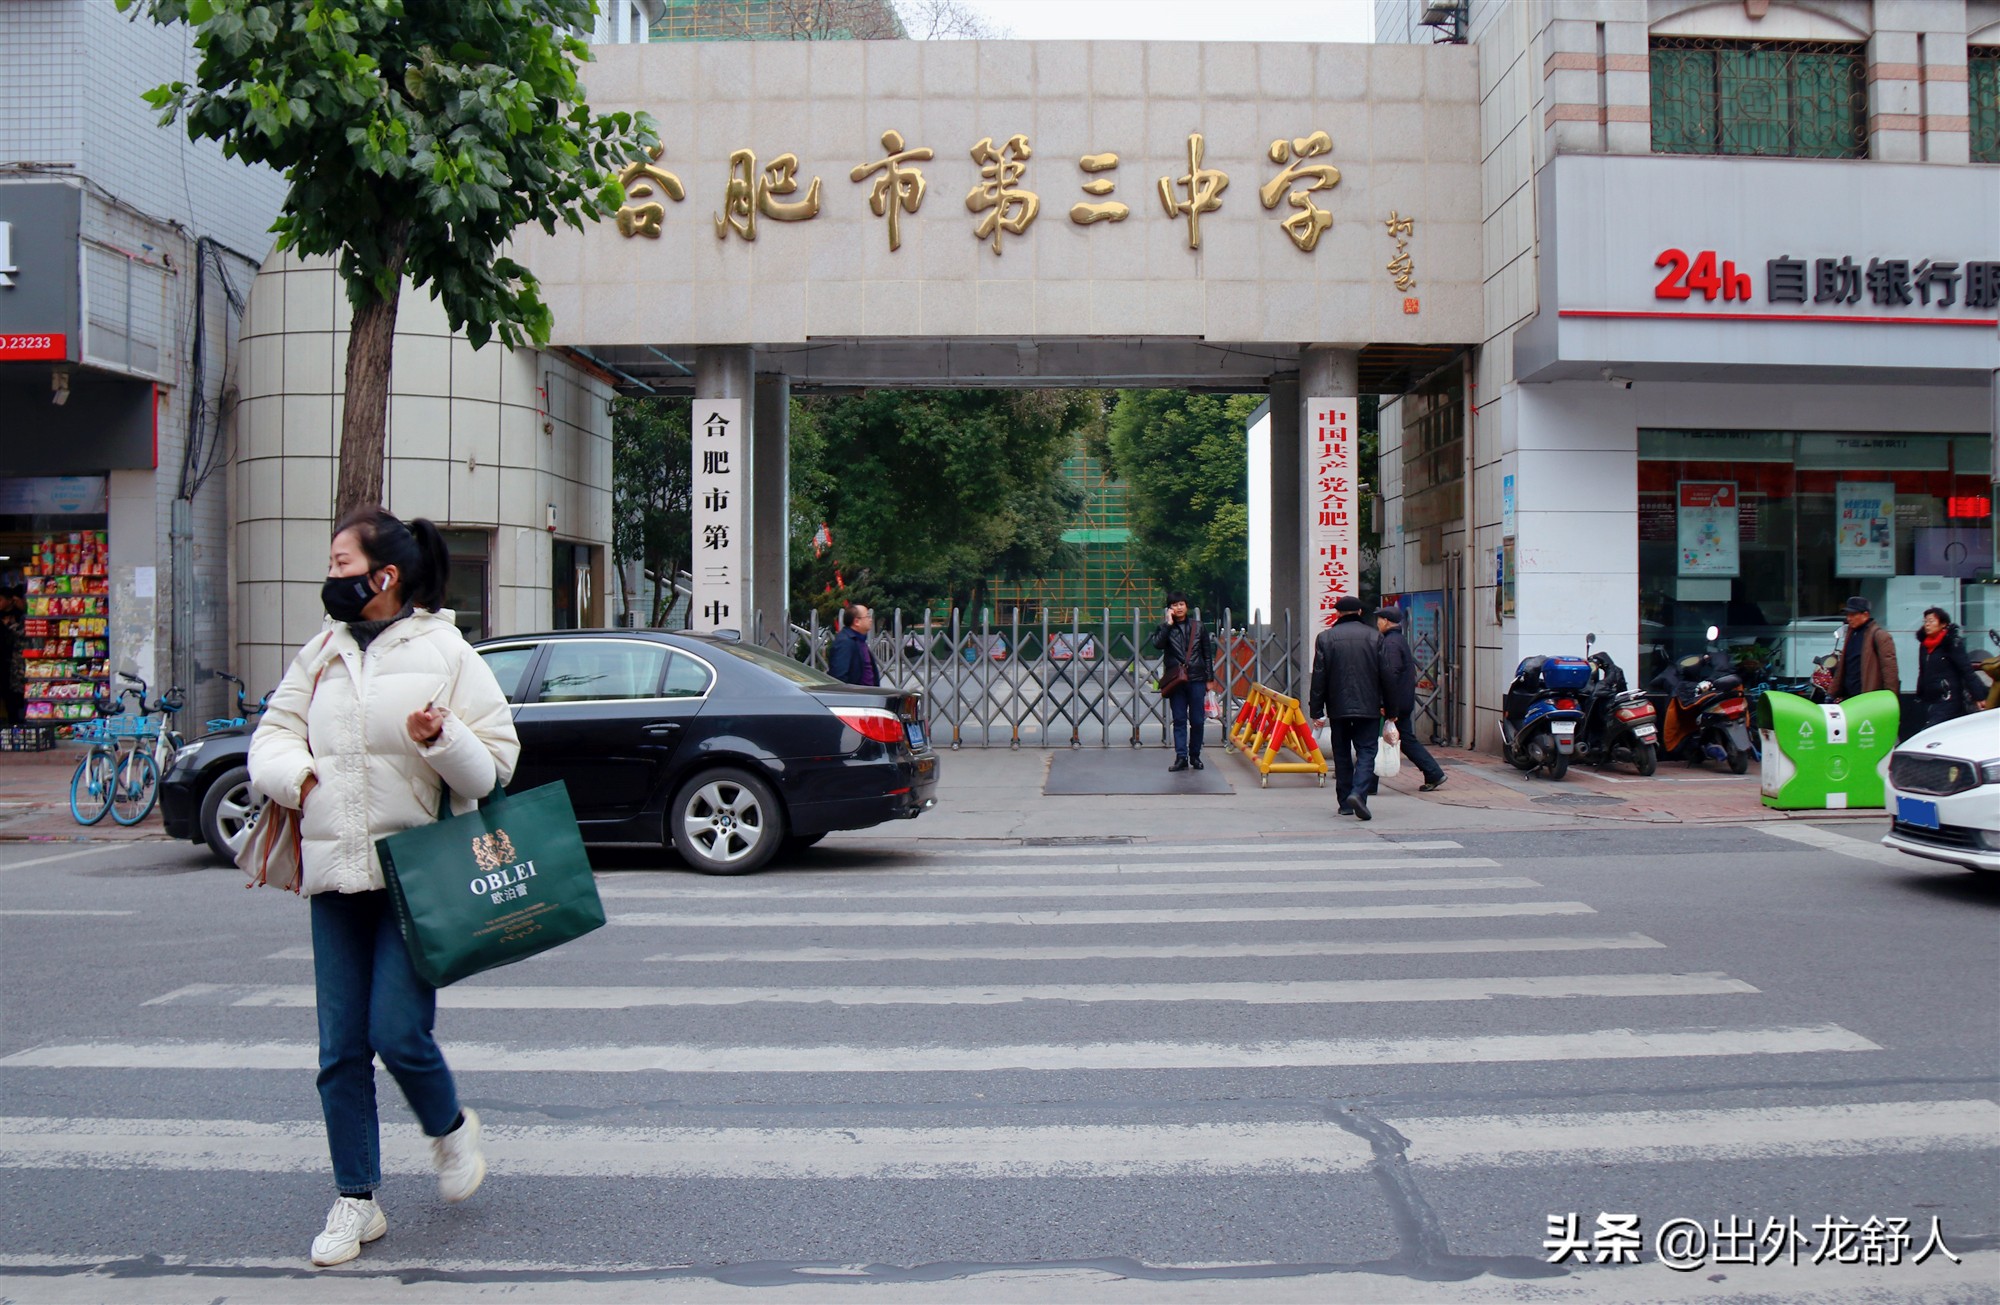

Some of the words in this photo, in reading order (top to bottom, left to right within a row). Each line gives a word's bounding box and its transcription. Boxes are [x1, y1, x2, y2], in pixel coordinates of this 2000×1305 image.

[615, 129, 1342, 255] 合肥市第三中学
[1654, 248, 1752, 302] 24h
[702, 412, 731, 626] 合肥市第三中
[470, 860, 538, 895] OBLEI
